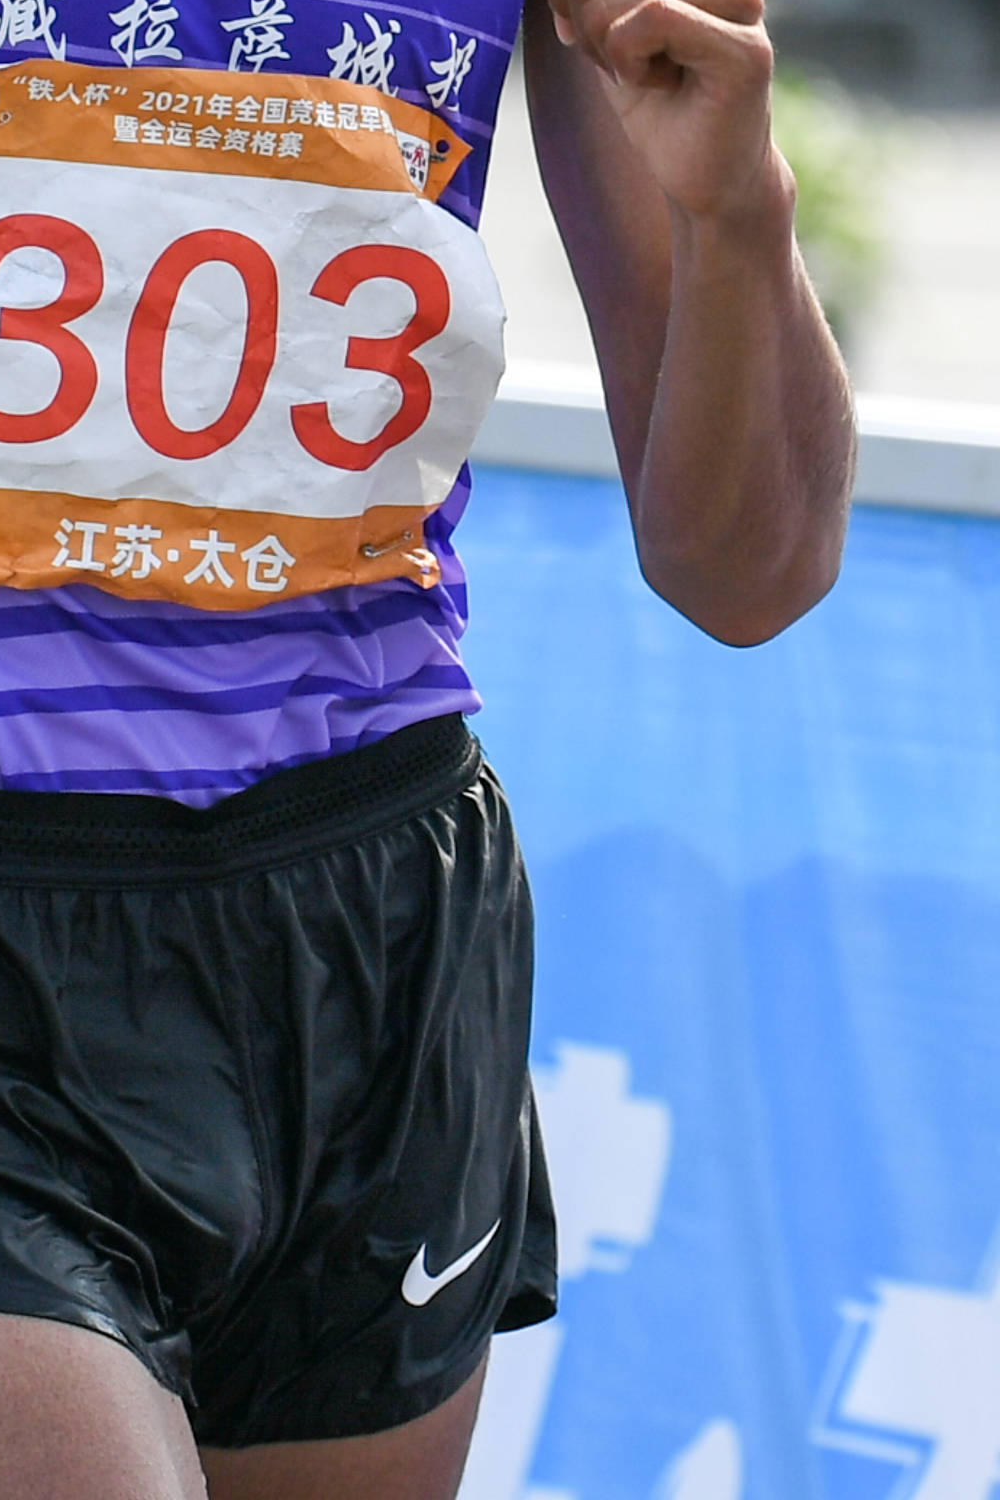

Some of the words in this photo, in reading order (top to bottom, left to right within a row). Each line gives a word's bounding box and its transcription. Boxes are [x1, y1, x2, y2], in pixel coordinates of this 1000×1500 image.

[112, 113, 304, 159] 暨全运会资格赛
[50, 516, 299, 595] 江苏·太仓
